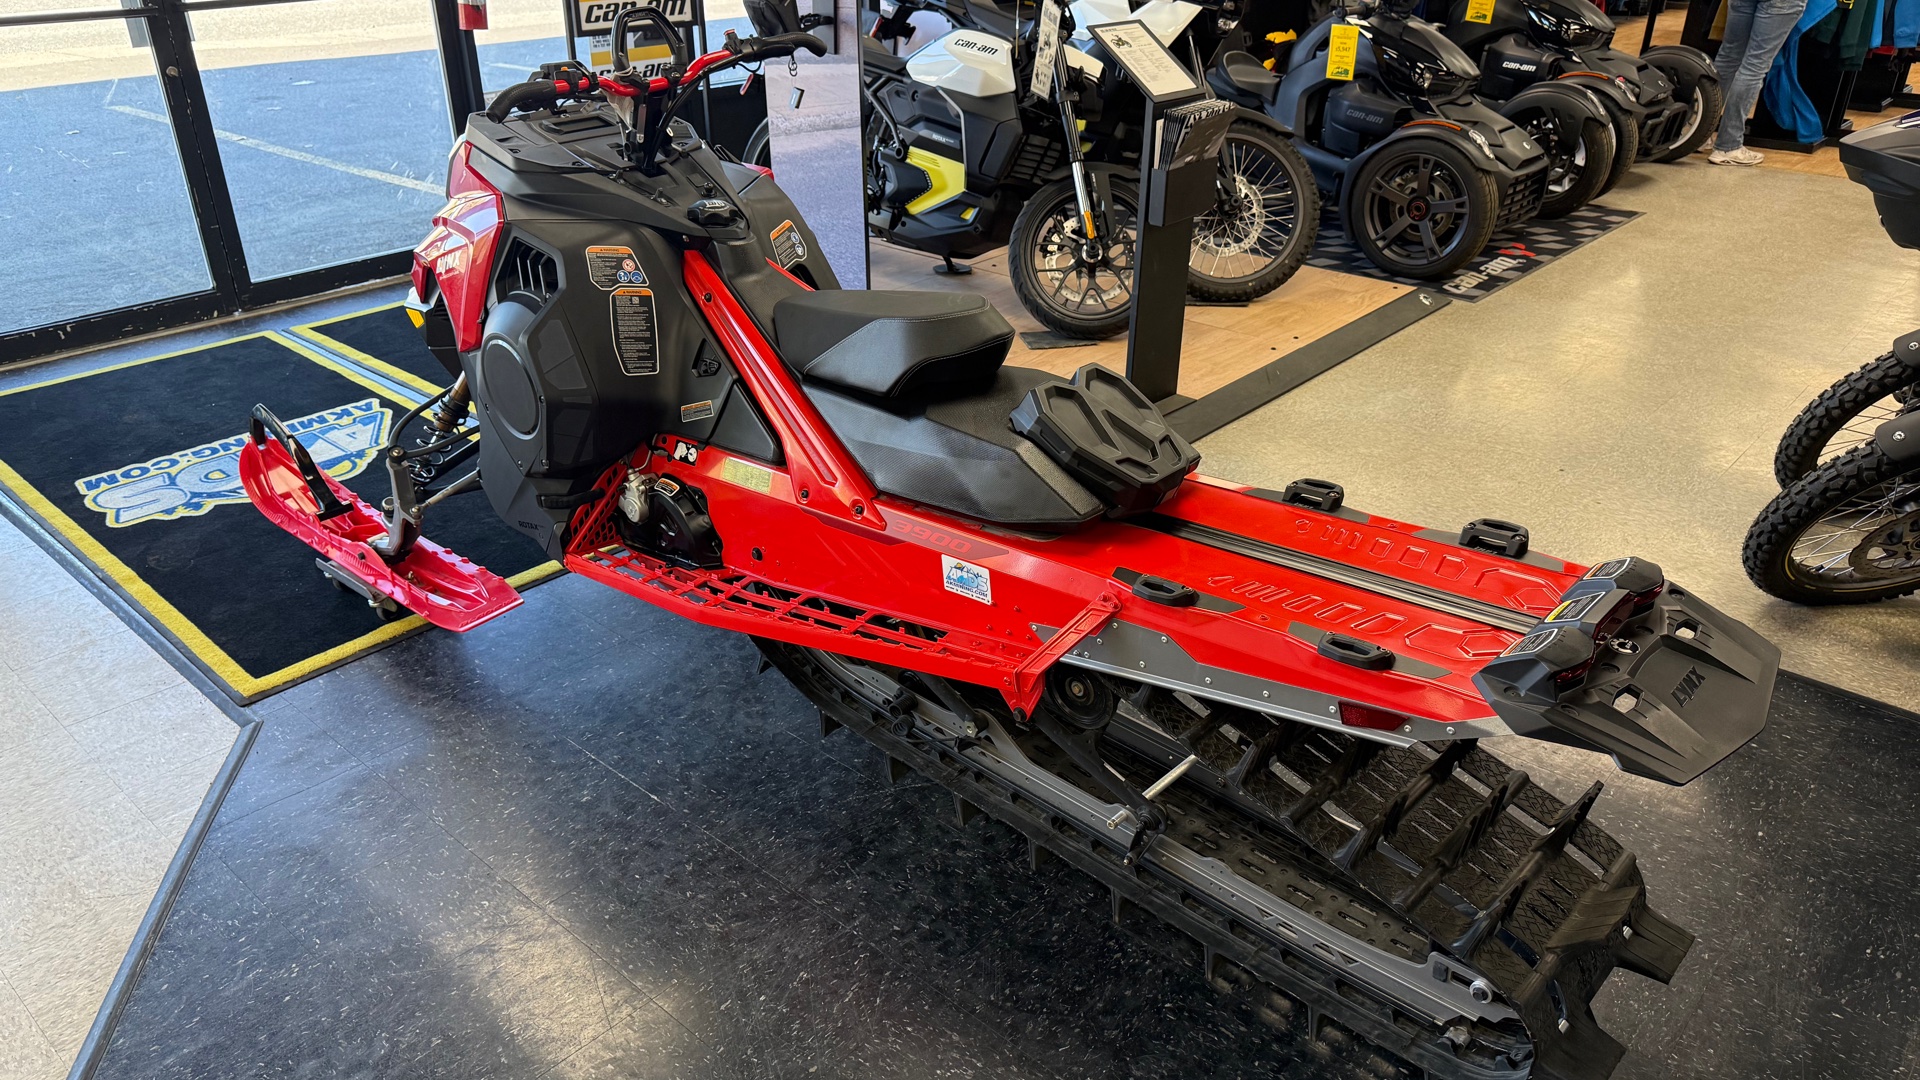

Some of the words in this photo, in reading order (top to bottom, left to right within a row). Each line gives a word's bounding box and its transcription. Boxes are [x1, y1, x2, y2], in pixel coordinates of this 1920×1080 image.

[954, 38, 998, 56] can-am
[1502, 61, 1537, 72] can-am
[1346, 109, 1384, 124] can-am
[436, 250, 463, 274] LYNX
[1442, 256, 1518, 294] can-am
[892, 520, 972, 553] 3900
[1670, 666, 1706, 708] LYNX
